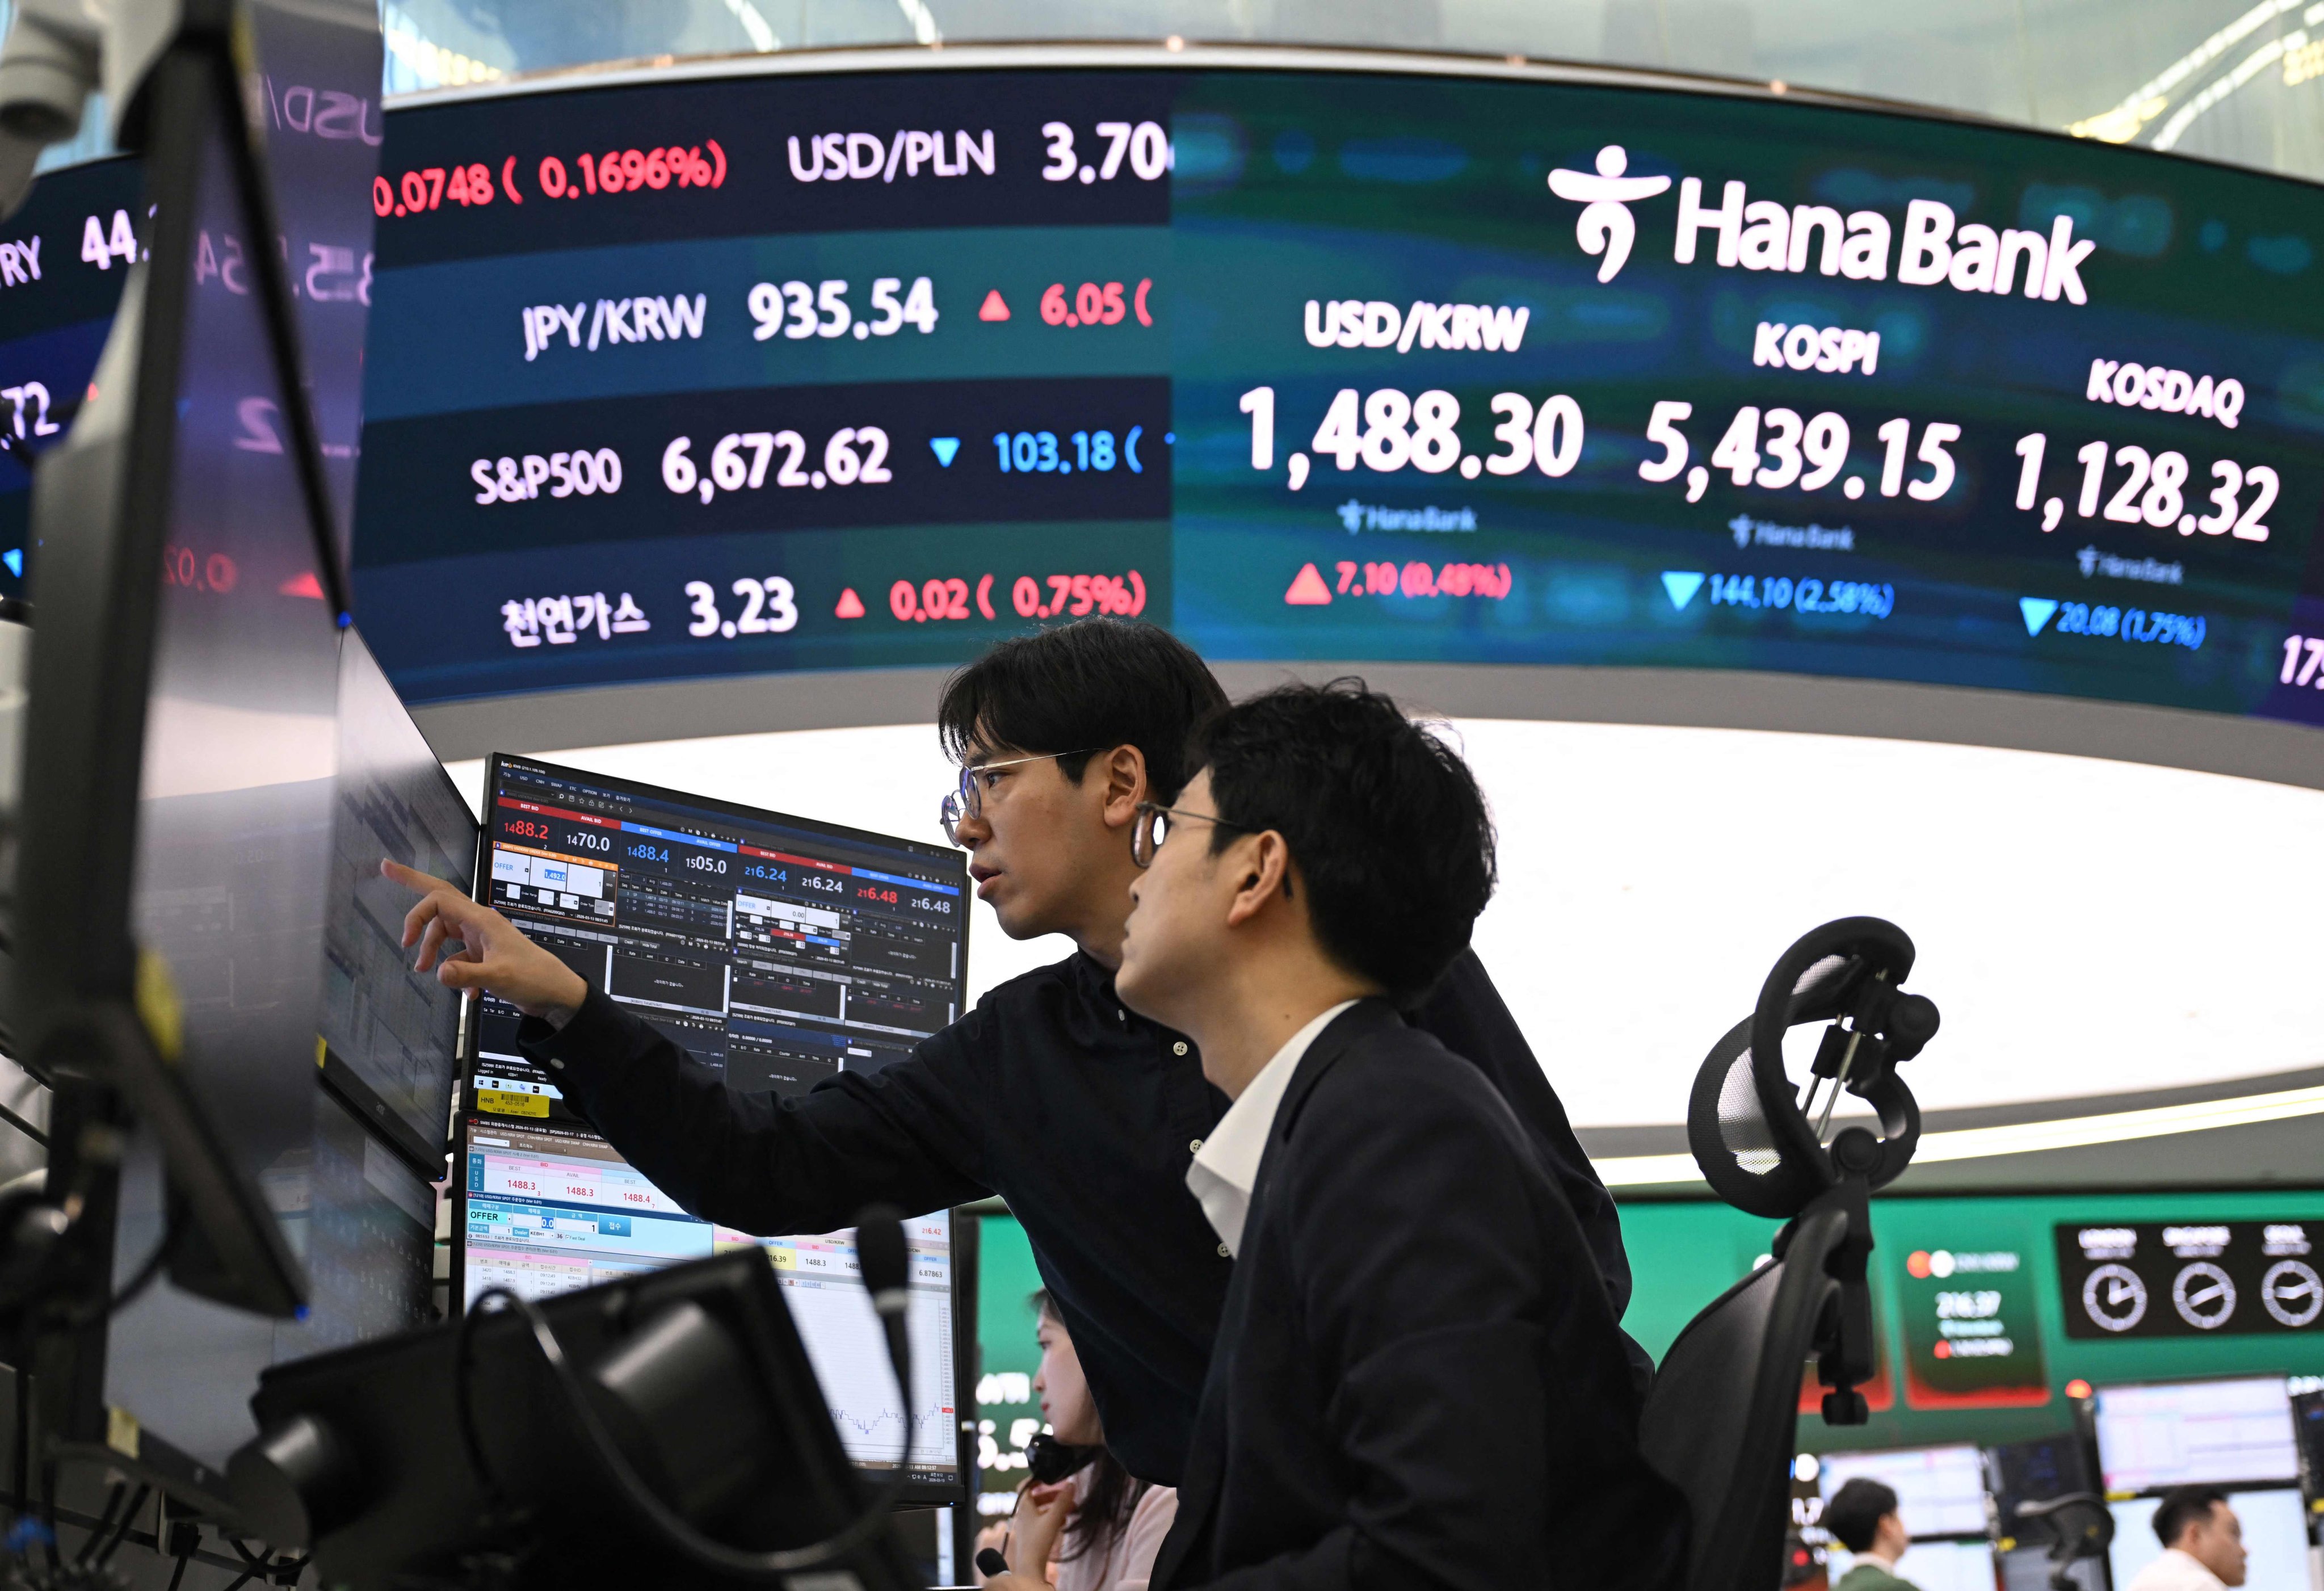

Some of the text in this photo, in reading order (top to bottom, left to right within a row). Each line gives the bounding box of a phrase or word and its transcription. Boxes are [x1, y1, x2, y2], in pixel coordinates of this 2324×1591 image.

[539, 140, 726, 199] 0.1696%)
[788, 129, 994, 182] USD/PLN
[1043, 121, 1174, 183] 3.70
[1675, 177, 2095, 305] Hana Bank
[523, 293, 707, 361] JPY/KRW
[747, 277, 939, 341] 935.54
[1304, 300, 1530, 354] USD/KRW
[1753, 321, 1881, 375] KOSPI
[2086, 358, 2245, 429] KOSDAQ
[1239, 387, 1584, 491] 1,488.30
[1638, 401, 1961, 503] 5,439.15
[471, 448, 622, 505] S&P500
[662, 426, 892, 504] 6,672.62
[2015, 433, 2279, 542] 1,128.32
[502, 592, 650, 648] 천연가스
[685, 576, 798, 639] 3.23
[505, 820, 549, 839] 1488.2
[567, 832, 610, 851] 1470.0
[627, 845, 669, 863] 1488.4
[494, 862, 513, 871] OFFER
[686, 855, 727, 874] 1505.0
[745, 866, 787, 883] 216.24
[802, 876, 843, 893] 216.24
[857, 887, 898, 904] 216.48
[738, 901, 755, 909] OFFER
[911, 898, 951, 914] 216.48
[507, 1179, 536, 1190] 1488.3
[566, 1186, 594, 1197] 1488.3
[624, 1193, 650, 1203] 1488.4
[470, 1212, 498, 1221] OFFER
[541, 1219, 554, 1228] 0.0
[609, 1221, 621, 1231] 접수
[805, 1258, 826, 1267] 1488.3
[919, 1269, 943, 1278] 6.87863
